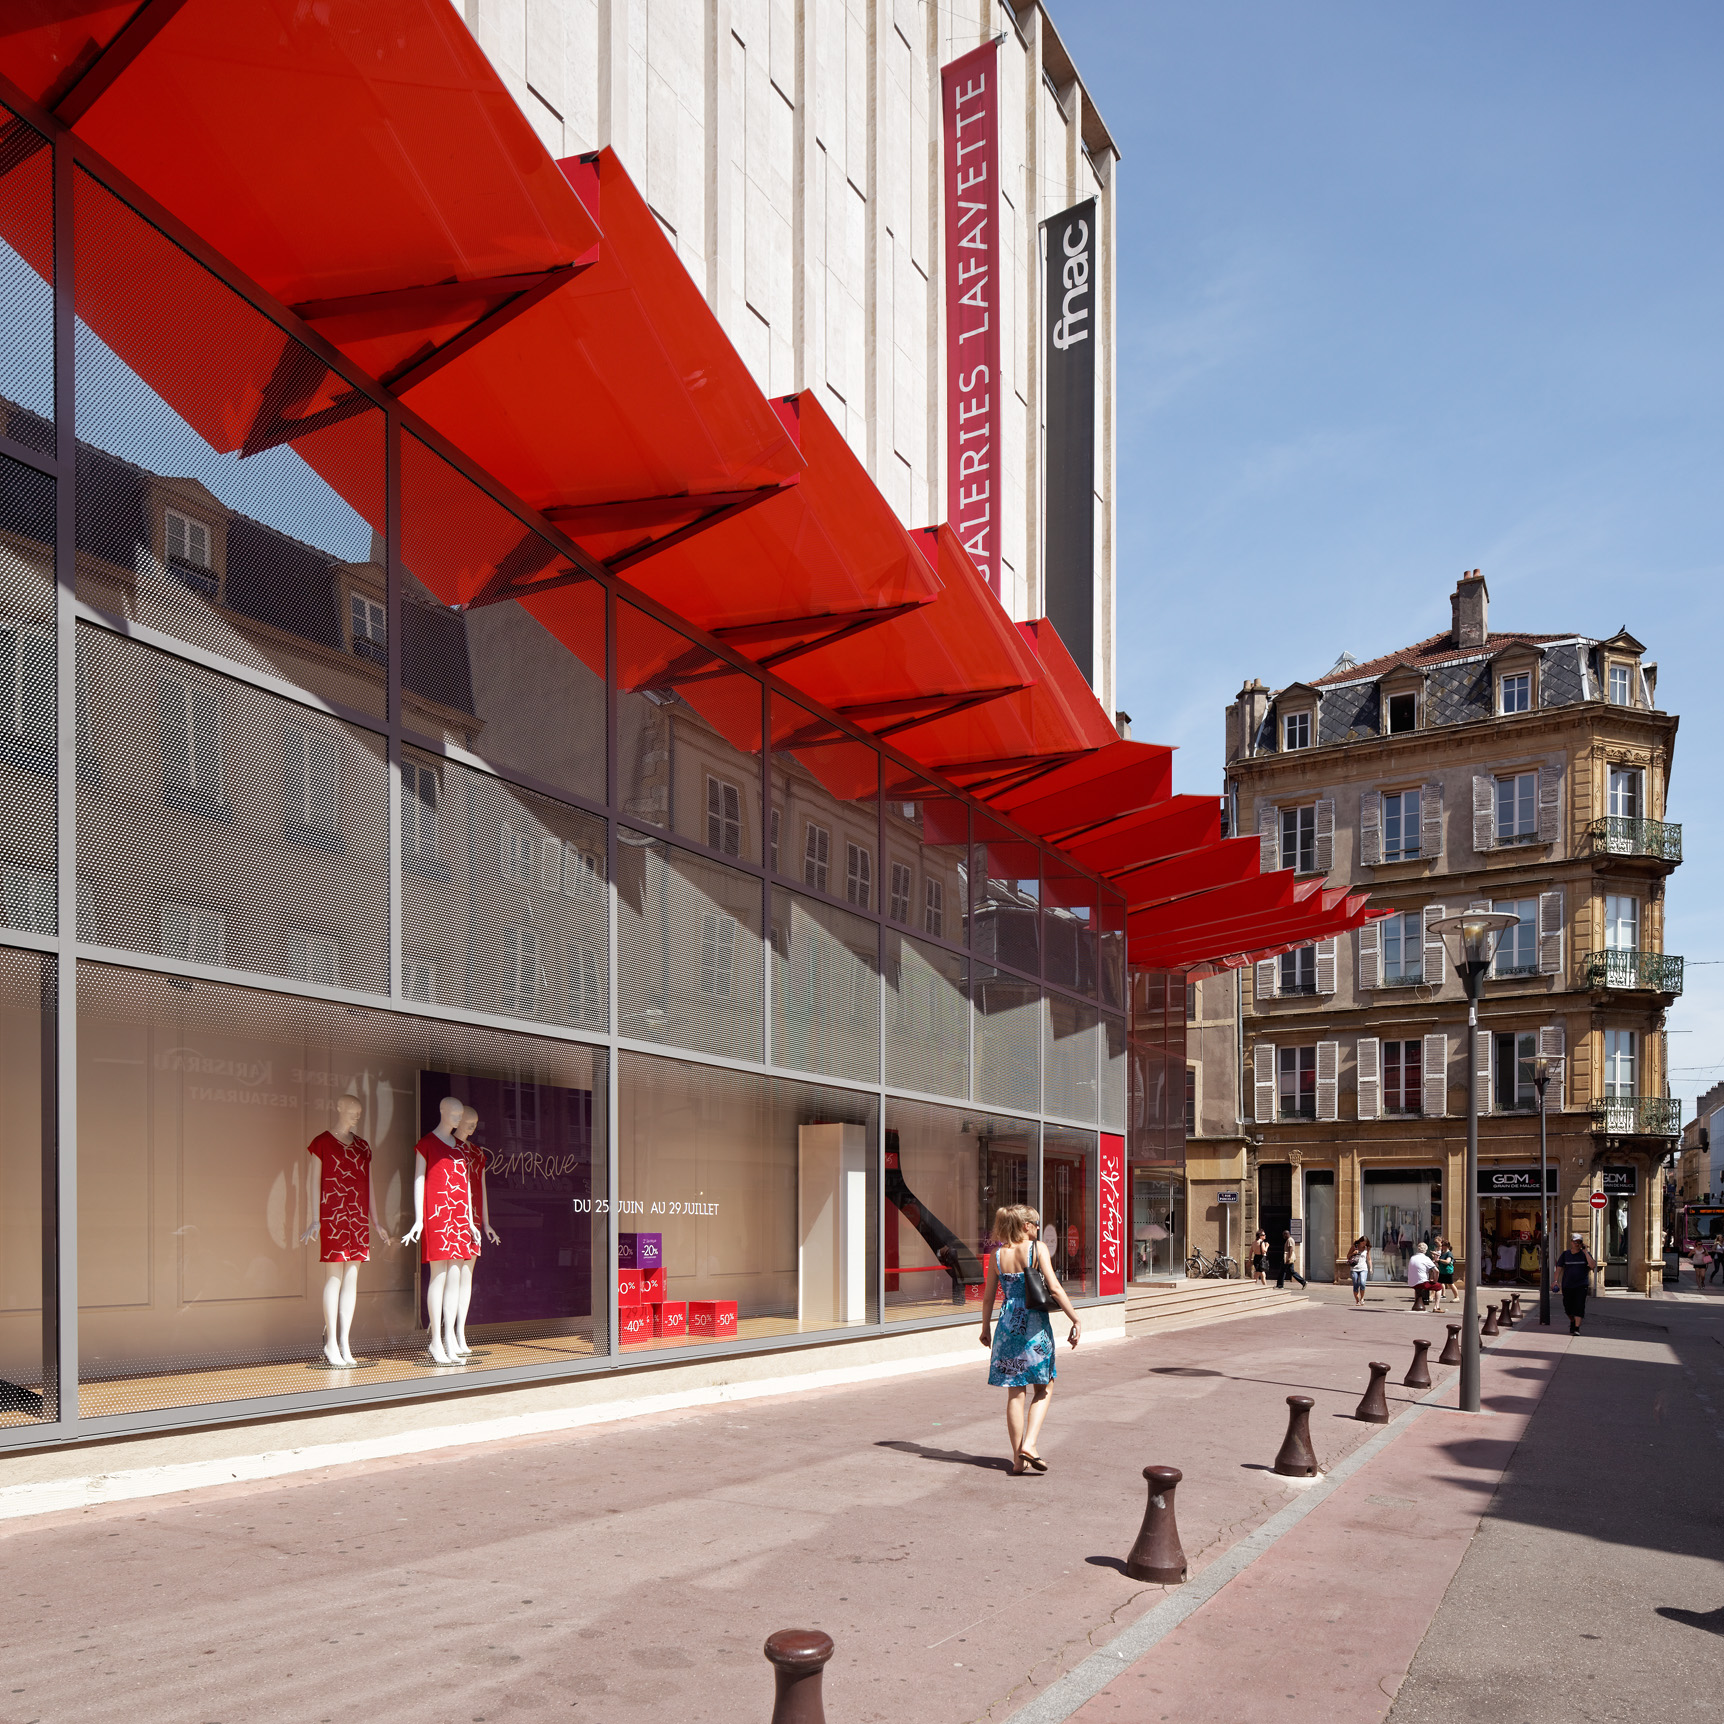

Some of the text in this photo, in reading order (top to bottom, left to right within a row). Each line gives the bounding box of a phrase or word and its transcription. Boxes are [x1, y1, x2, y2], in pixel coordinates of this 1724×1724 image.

[955, 72, 989, 345] LAFAYETTE
[1053, 218, 1089, 351] fnac
[1492, 1173, 1529, 1184] GDM
[573, 1199, 592, 1213] DU
[595, 1199, 609, 1213] 25
[650, 1201, 666, 1214] AU
[669, 1201, 682, 1215] 29
[682, 1202, 719, 1216] JUILLET
[641, 1244, 659, 1256] -20%
[618, 1281, 636, 1295] 0%
[624, 1318, 644, 1333] -40%
[664, 1313, 683, 1327] -30%
[691, 1314, 712, 1326] -50%
[717, 1313, 735, 1326] -50%
